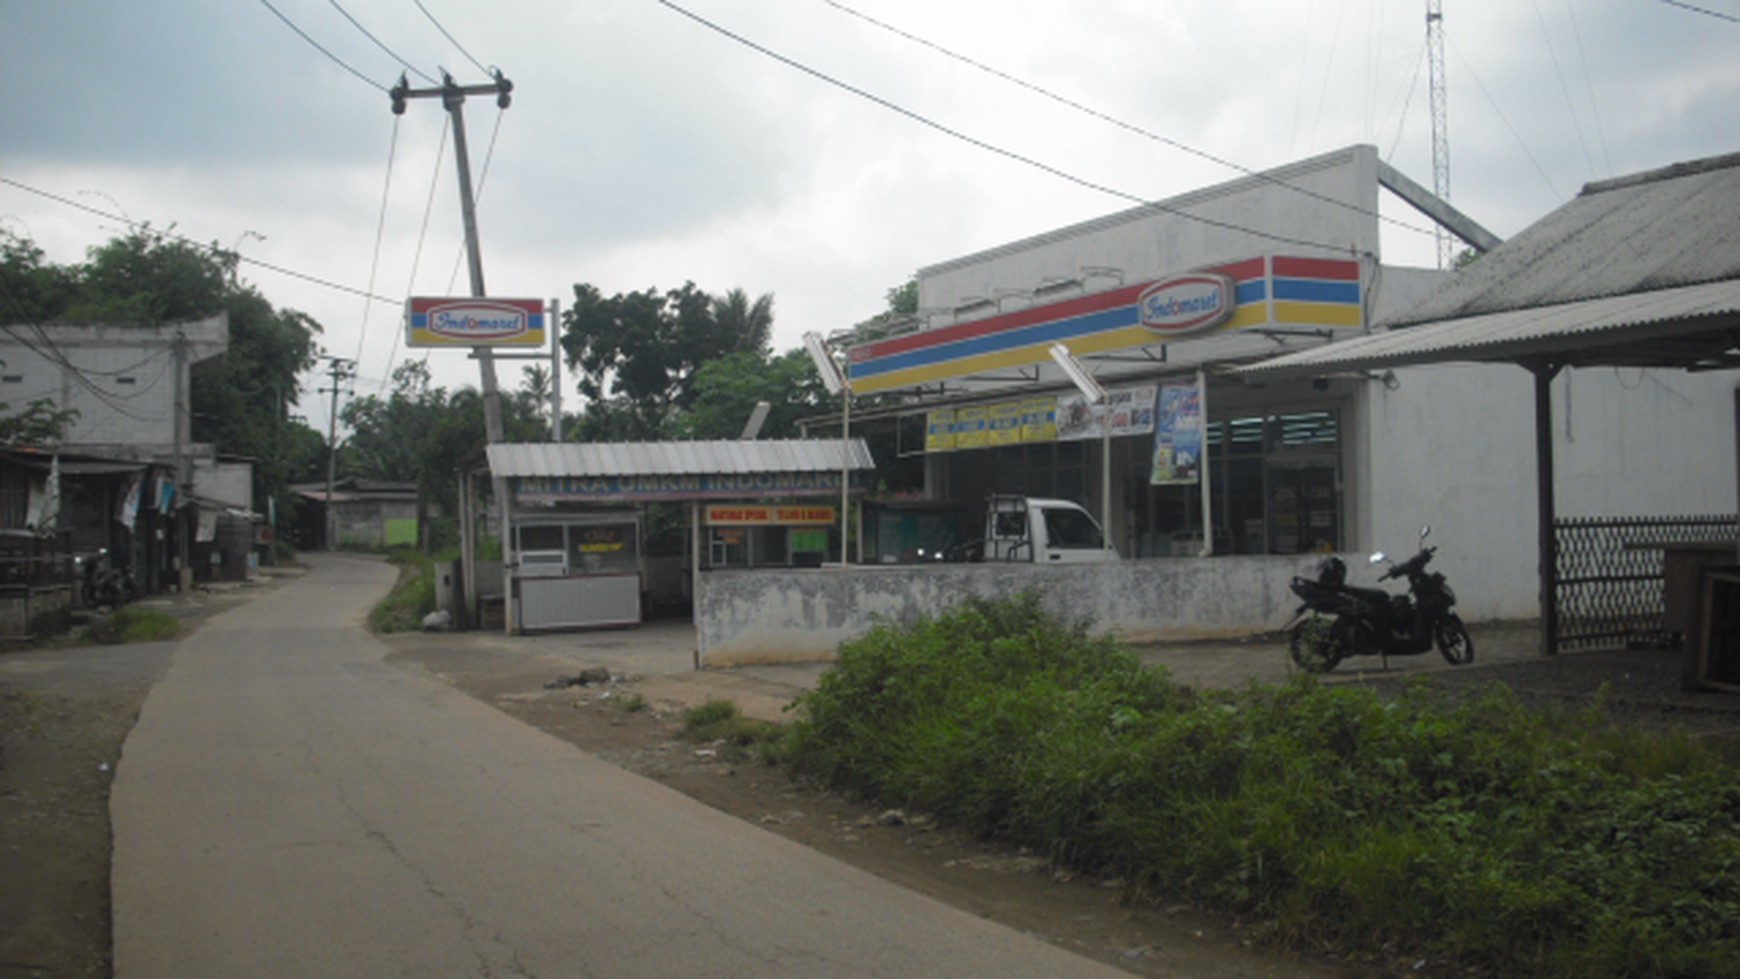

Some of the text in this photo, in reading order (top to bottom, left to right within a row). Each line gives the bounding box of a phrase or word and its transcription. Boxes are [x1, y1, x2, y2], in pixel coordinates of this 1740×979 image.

[1146, 287, 1219, 320] Indomaret
[435, 313, 520, 331] Indomaret
[521, 475, 609, 492] MITRA
[618, 474, 700, 491] UMKM
